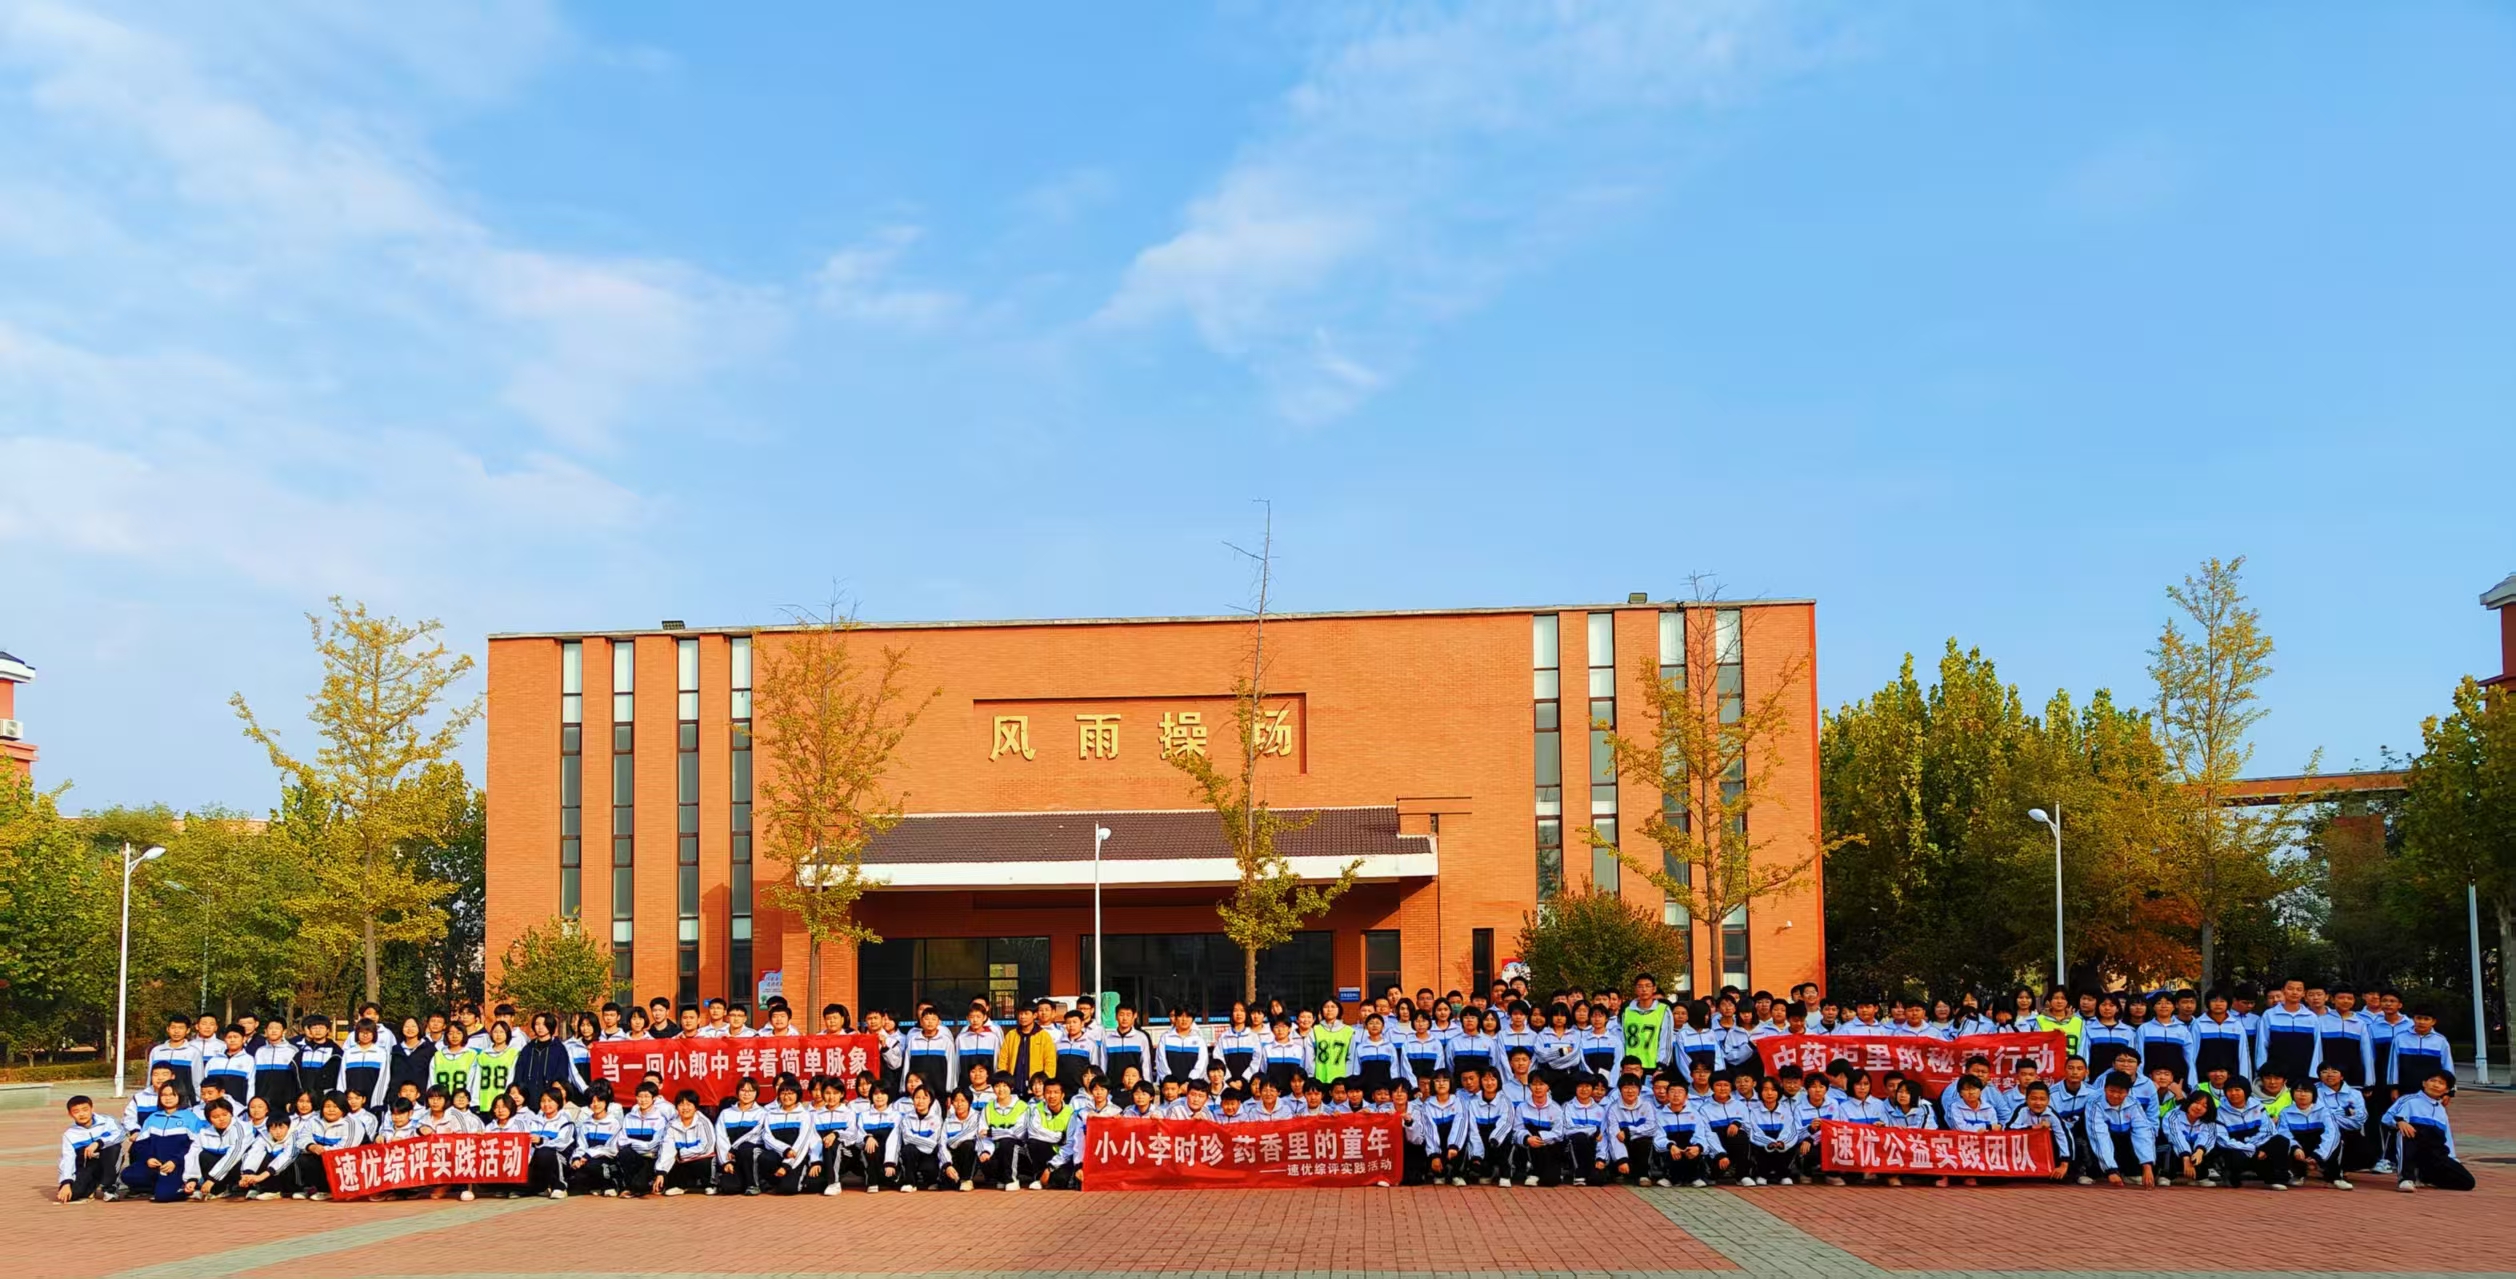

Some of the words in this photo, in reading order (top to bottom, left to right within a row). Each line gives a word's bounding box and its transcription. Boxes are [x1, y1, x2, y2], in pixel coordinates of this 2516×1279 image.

[988, 709, 1293, 762] 风雨操场
[1317, 1039, 1345, 1065] 87
[1627, 1023, 1656, 1050] 87
[335, 1136, 523, 1193] 速优综评实践活动
[1830, 1125, 2037, 1173] 速优公益实践团队
